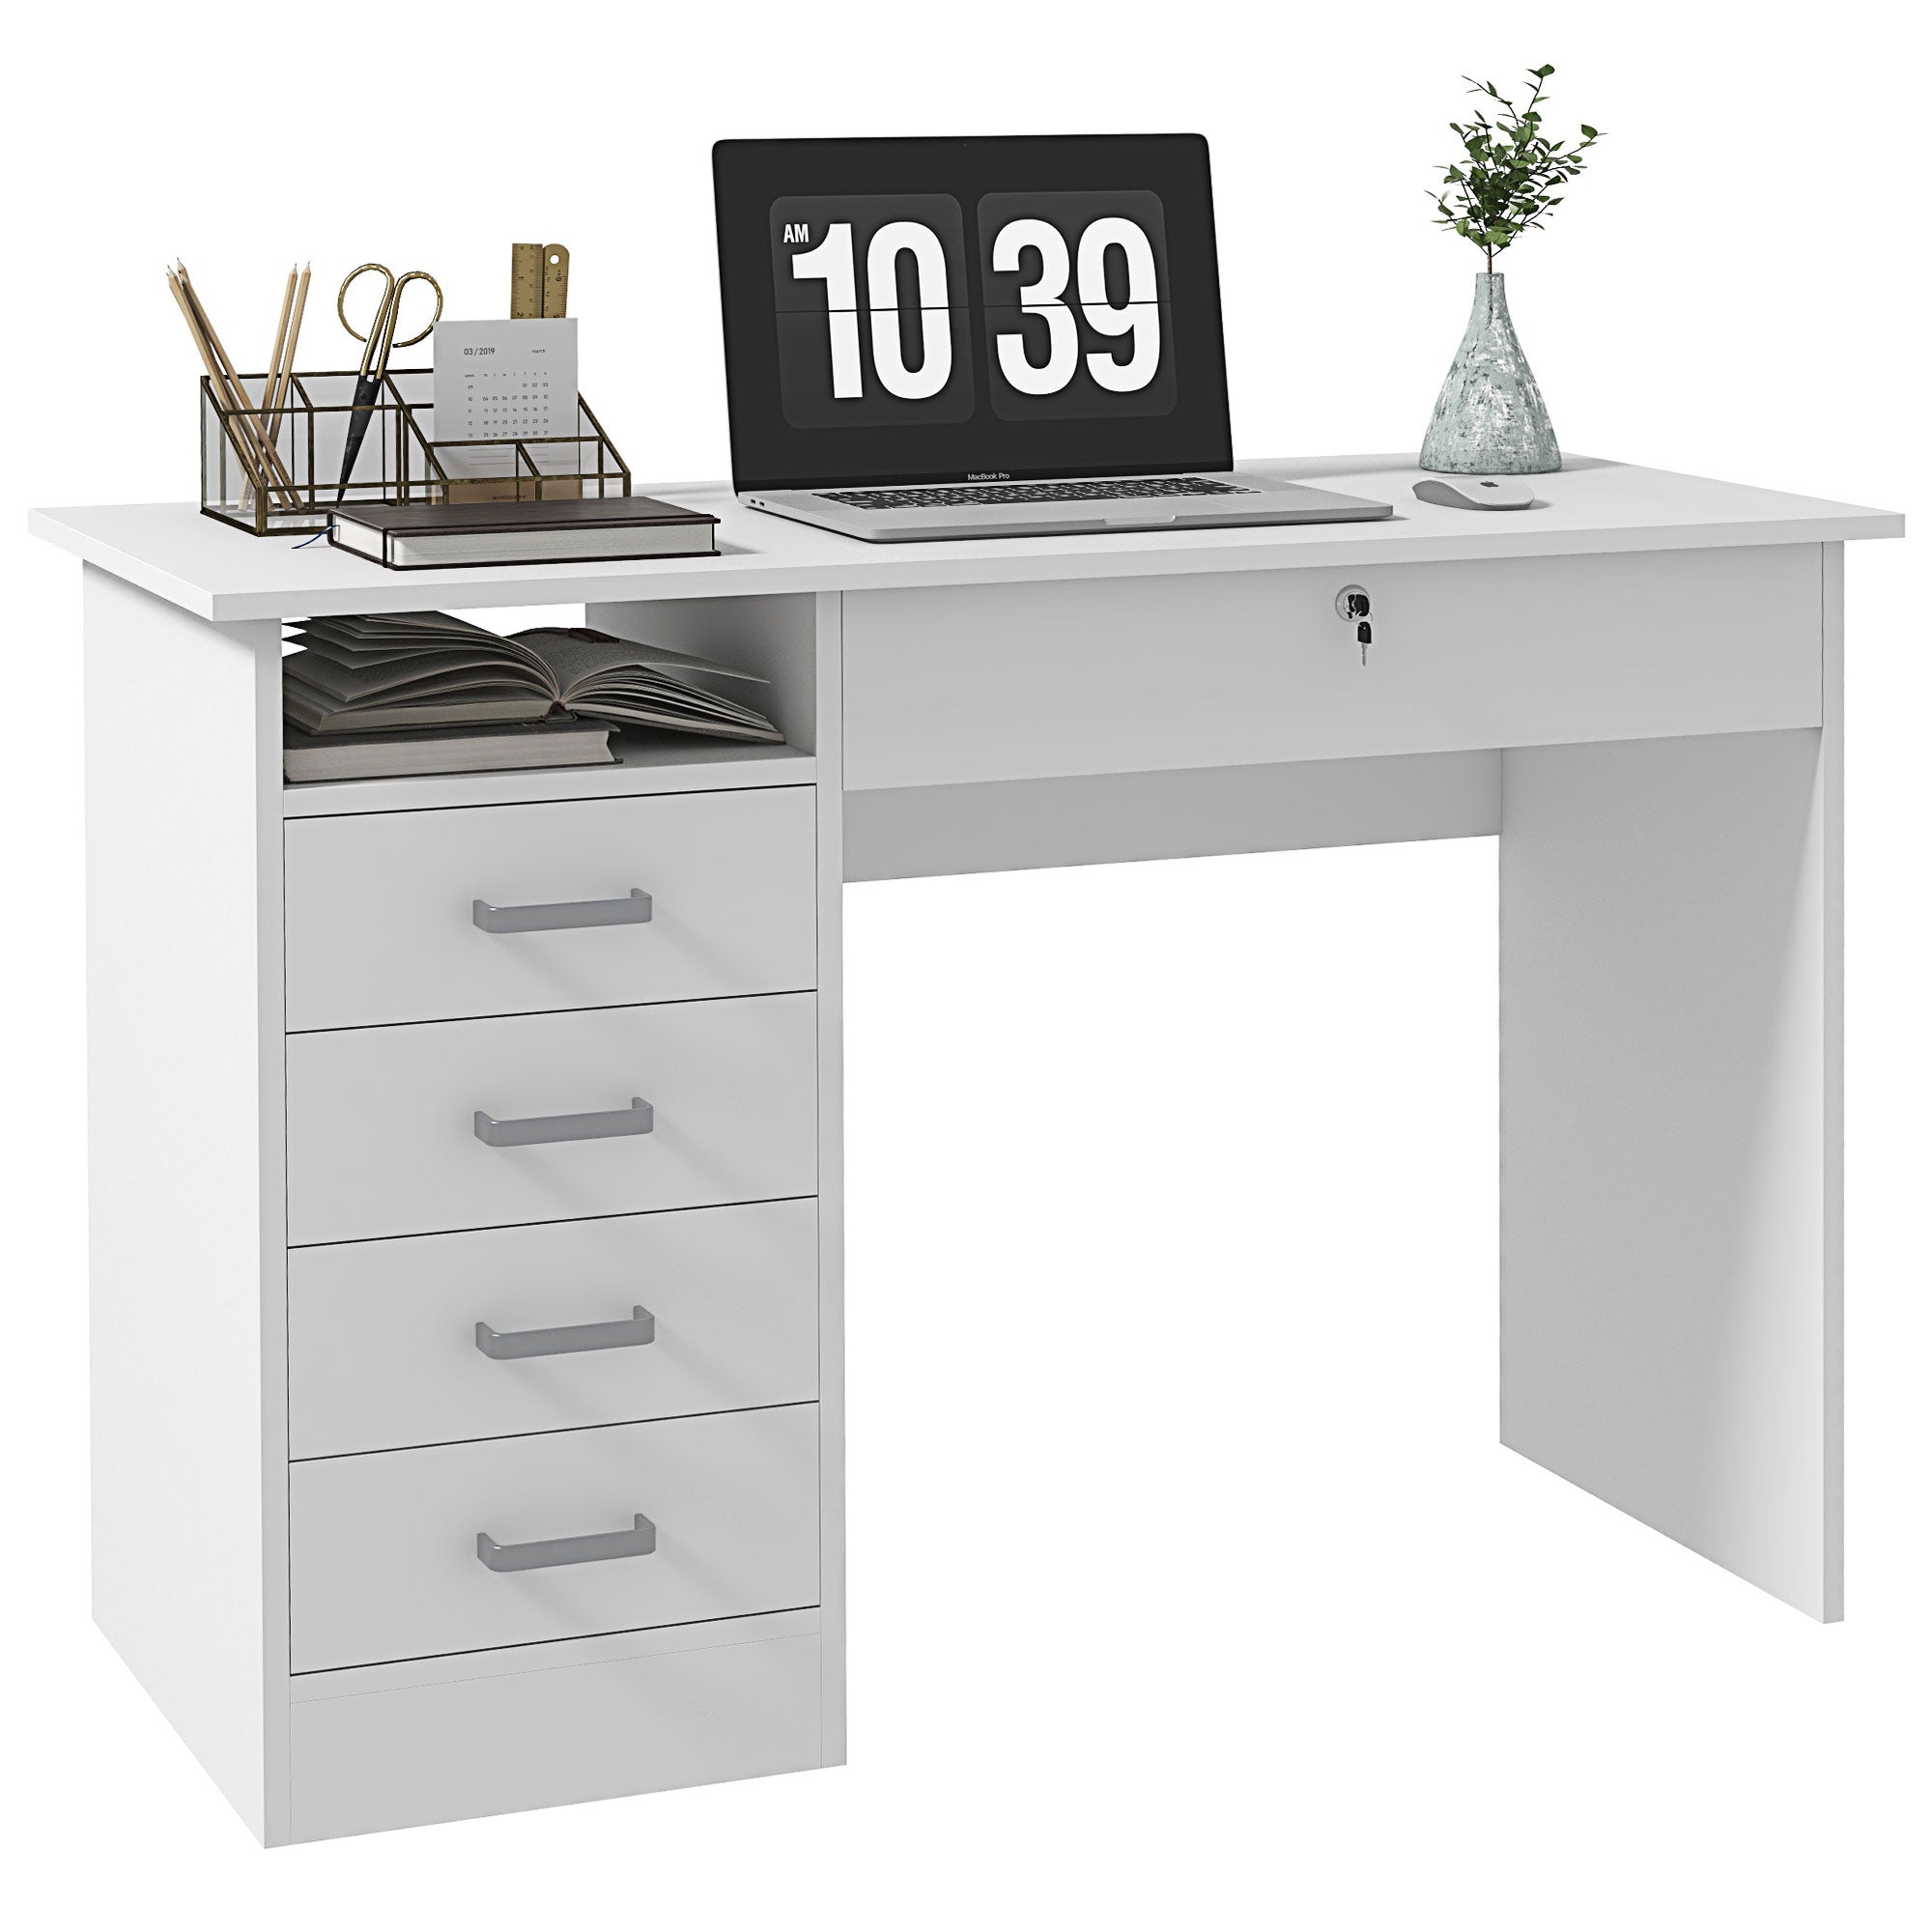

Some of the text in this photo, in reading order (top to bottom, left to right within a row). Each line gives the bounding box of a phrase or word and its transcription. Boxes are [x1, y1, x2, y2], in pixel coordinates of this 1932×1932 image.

[783, 224, 809, 242] AM
[792, 217, 1159, 399] 10 39
